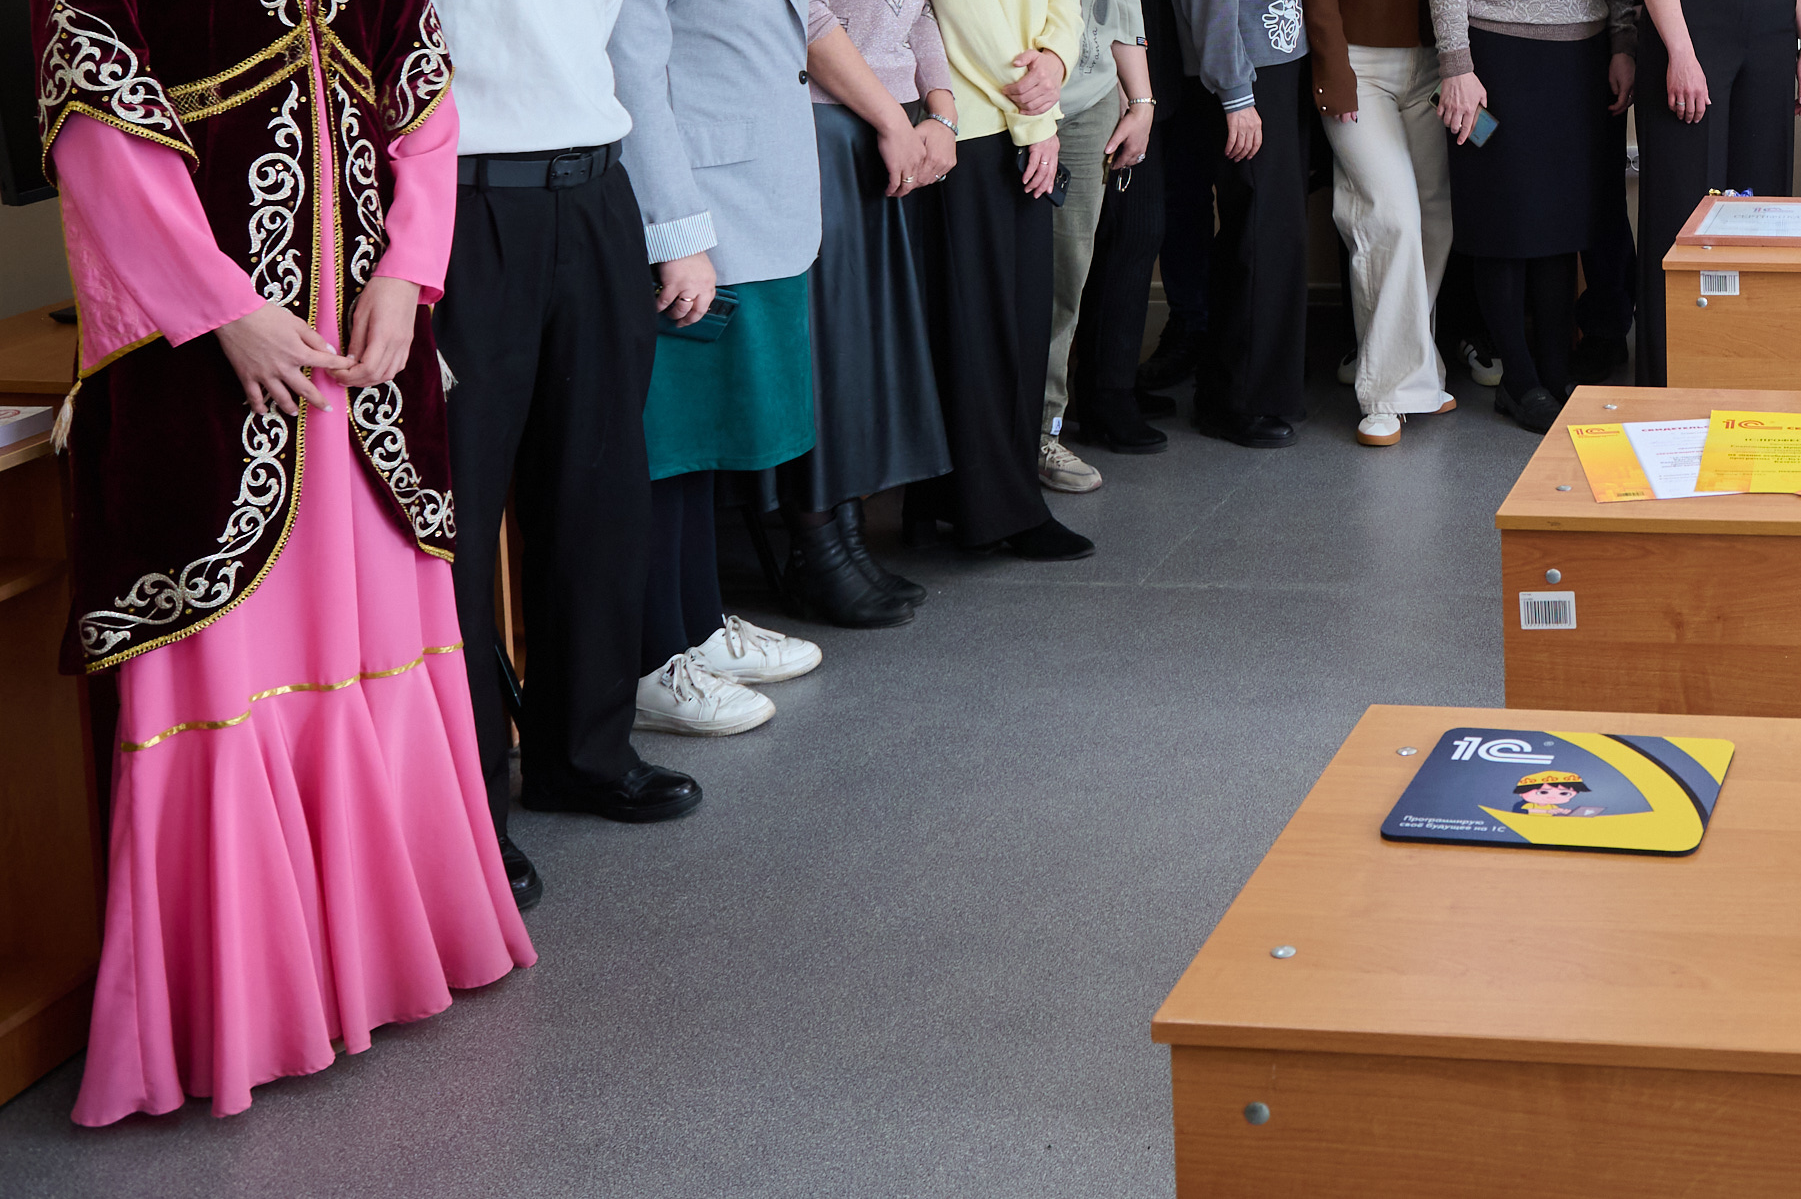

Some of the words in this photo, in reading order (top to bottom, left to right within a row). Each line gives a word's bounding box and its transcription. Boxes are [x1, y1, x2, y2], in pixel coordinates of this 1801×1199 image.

[1451, 737, 1554, 765] 1С
[1403, 815, 1485, 826] Программирую
[1426, 822, 1472, 831] будущее
